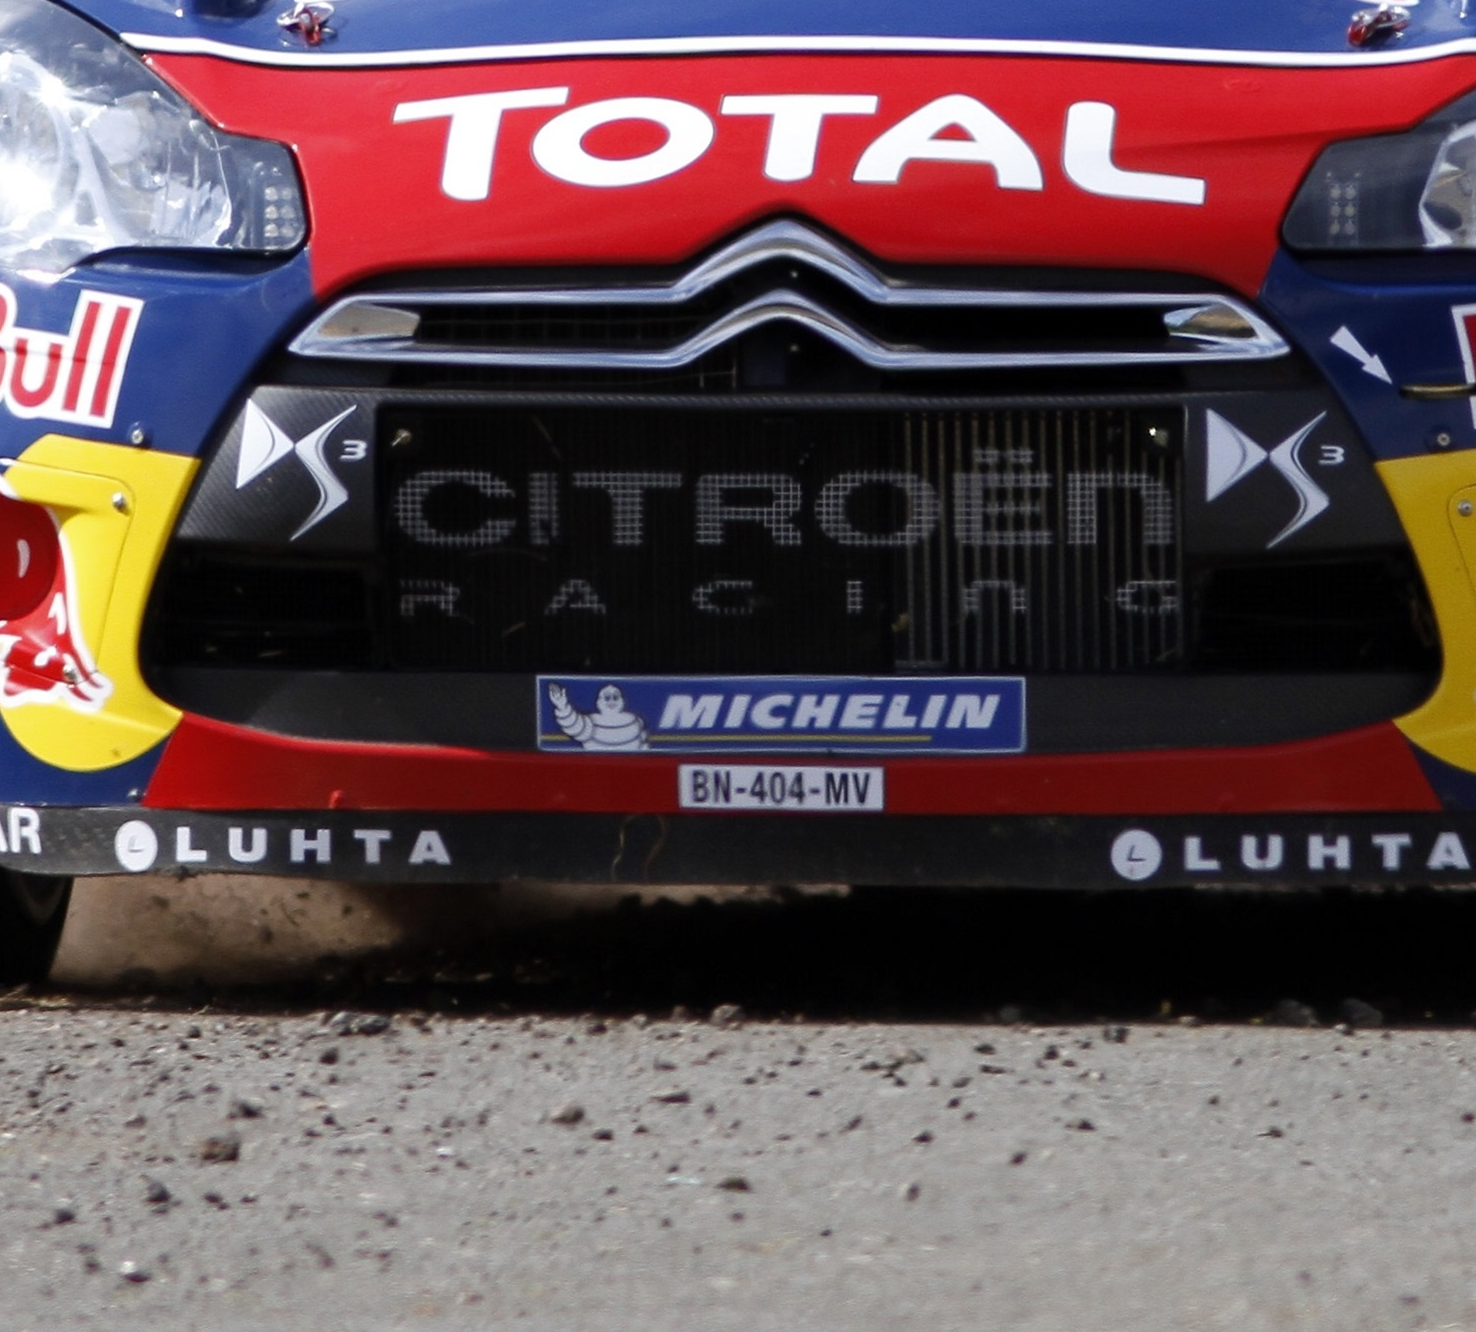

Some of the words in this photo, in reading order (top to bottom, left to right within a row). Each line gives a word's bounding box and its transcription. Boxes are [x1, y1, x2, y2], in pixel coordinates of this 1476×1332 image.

[393, 87, 1207, 205] TOTAL
[395, 448, 1175, 547] CITROËN
[659, 694, 1000, 729] MICHELIN
[692, 770, 870, 805] BN-404-MV
[176, 826, 451, 865] LUHTA
[1185, 833, 1470, 871] LUHTA
